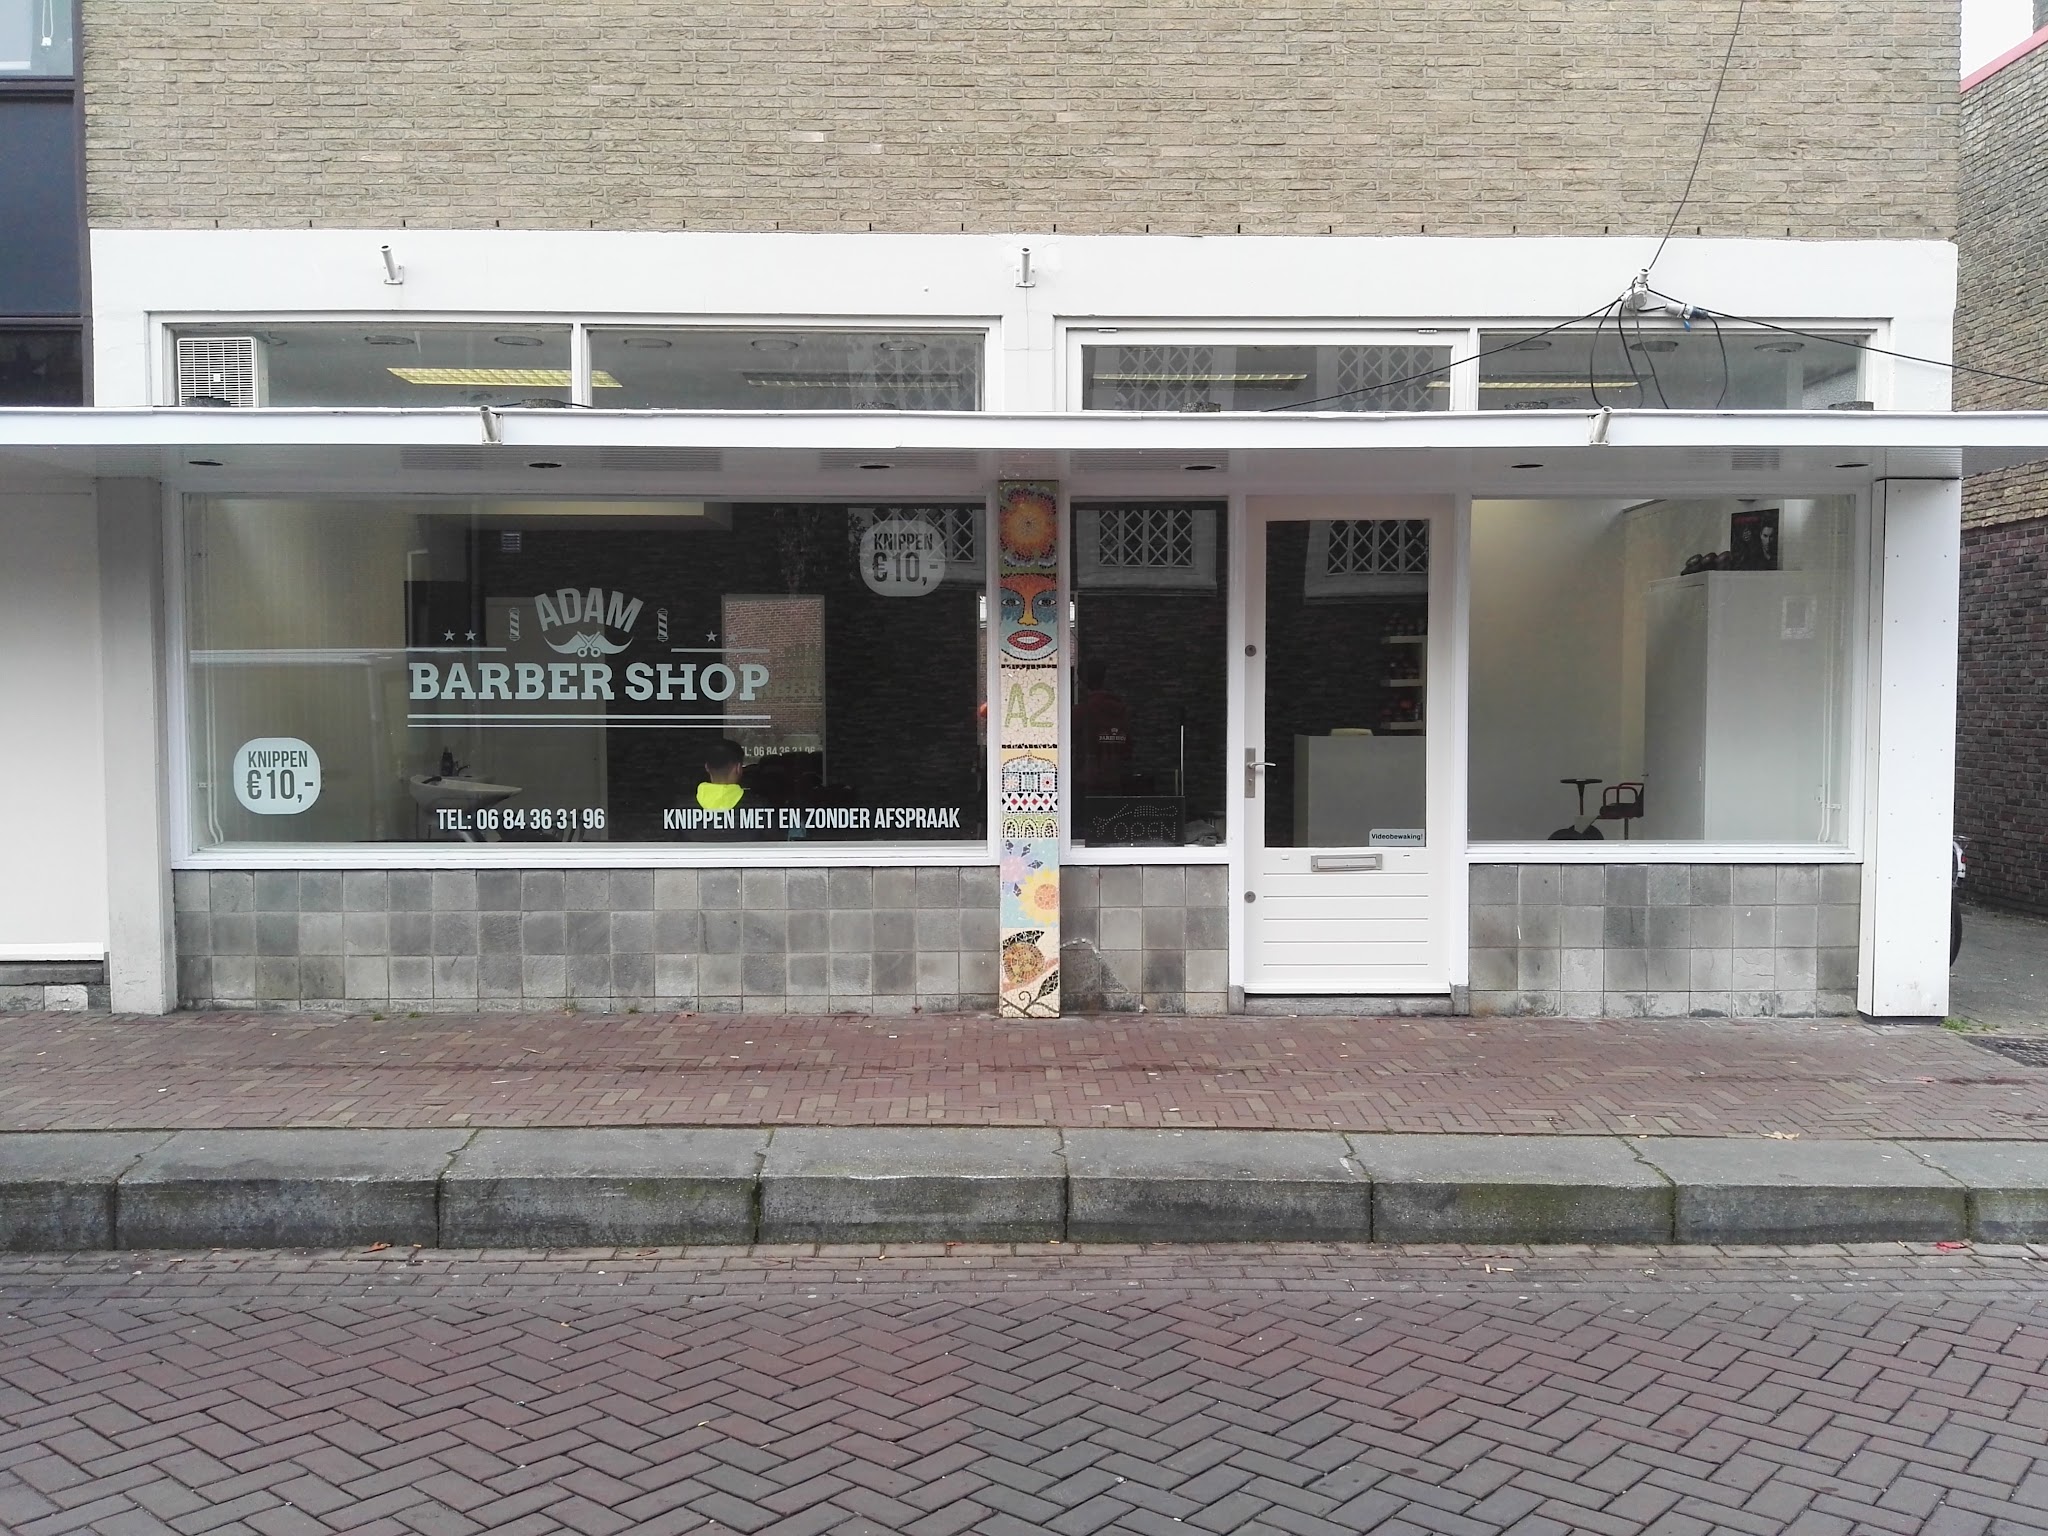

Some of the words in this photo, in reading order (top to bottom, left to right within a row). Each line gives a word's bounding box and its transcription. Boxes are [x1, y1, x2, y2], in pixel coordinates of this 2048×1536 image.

[874, 533, 933, 551] KNIPPEN
[534, 587, 645, 633] ADAM
[409, 662, 615, 700] BARBER
[625, 662, 770, 701] SHOP
[1004, 682, 1056, 728] A2
[247, 750, 308, 768] KNIPPEN
[754, 746, 765, 757] 06
[246, 769, 314, 803] €10,-
[436, 808, 472, 830] TEL:
[476, 808, 499, 830] 06
[503, 808, 526, 830] 84
[530, 808, 551, 830] 36
[556, 808, 577, 830] 31
[583, 808, 605, 829] 96
[663, 808, 735, 830] KNIPPEN
[739, 808, 775, 830] MET
[779, 808, 801, 829] EN
[805, 808, 871, 829] ZONDER
[874, 807, 961, 829] AFSPRAAK
[1371, 833, 1424, 841] Videobewaking!
